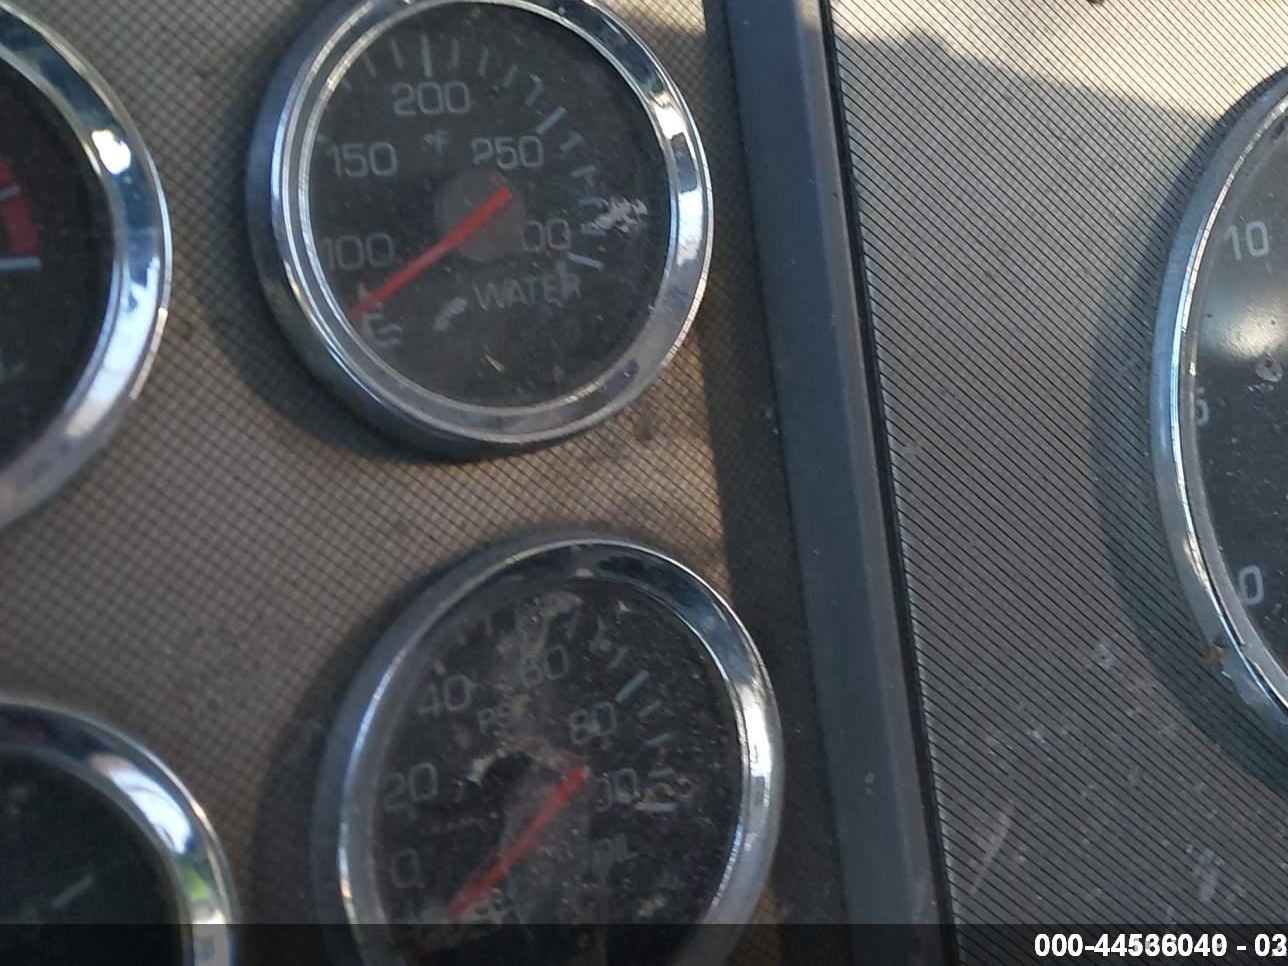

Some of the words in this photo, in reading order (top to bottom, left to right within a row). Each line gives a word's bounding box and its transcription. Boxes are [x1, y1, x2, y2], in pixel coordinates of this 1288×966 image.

[392, 81, 471, 116] 200
[327, 141, 398, 177] 150
[470, 135, 545, 170] 250
[320, 233, 396, 271] 100
[521, 220, 572, 254] 00
[1224, 219, 1271, 261] 10
[473, 272, 583, 311] WATER
[1236, 564, 1265, 607] 0
[416, 674, 473, 718] 40
[568, 701, 617, 744] 80
[381, 762, 439, 813] 20
[389, 848, 422, 889] 0
